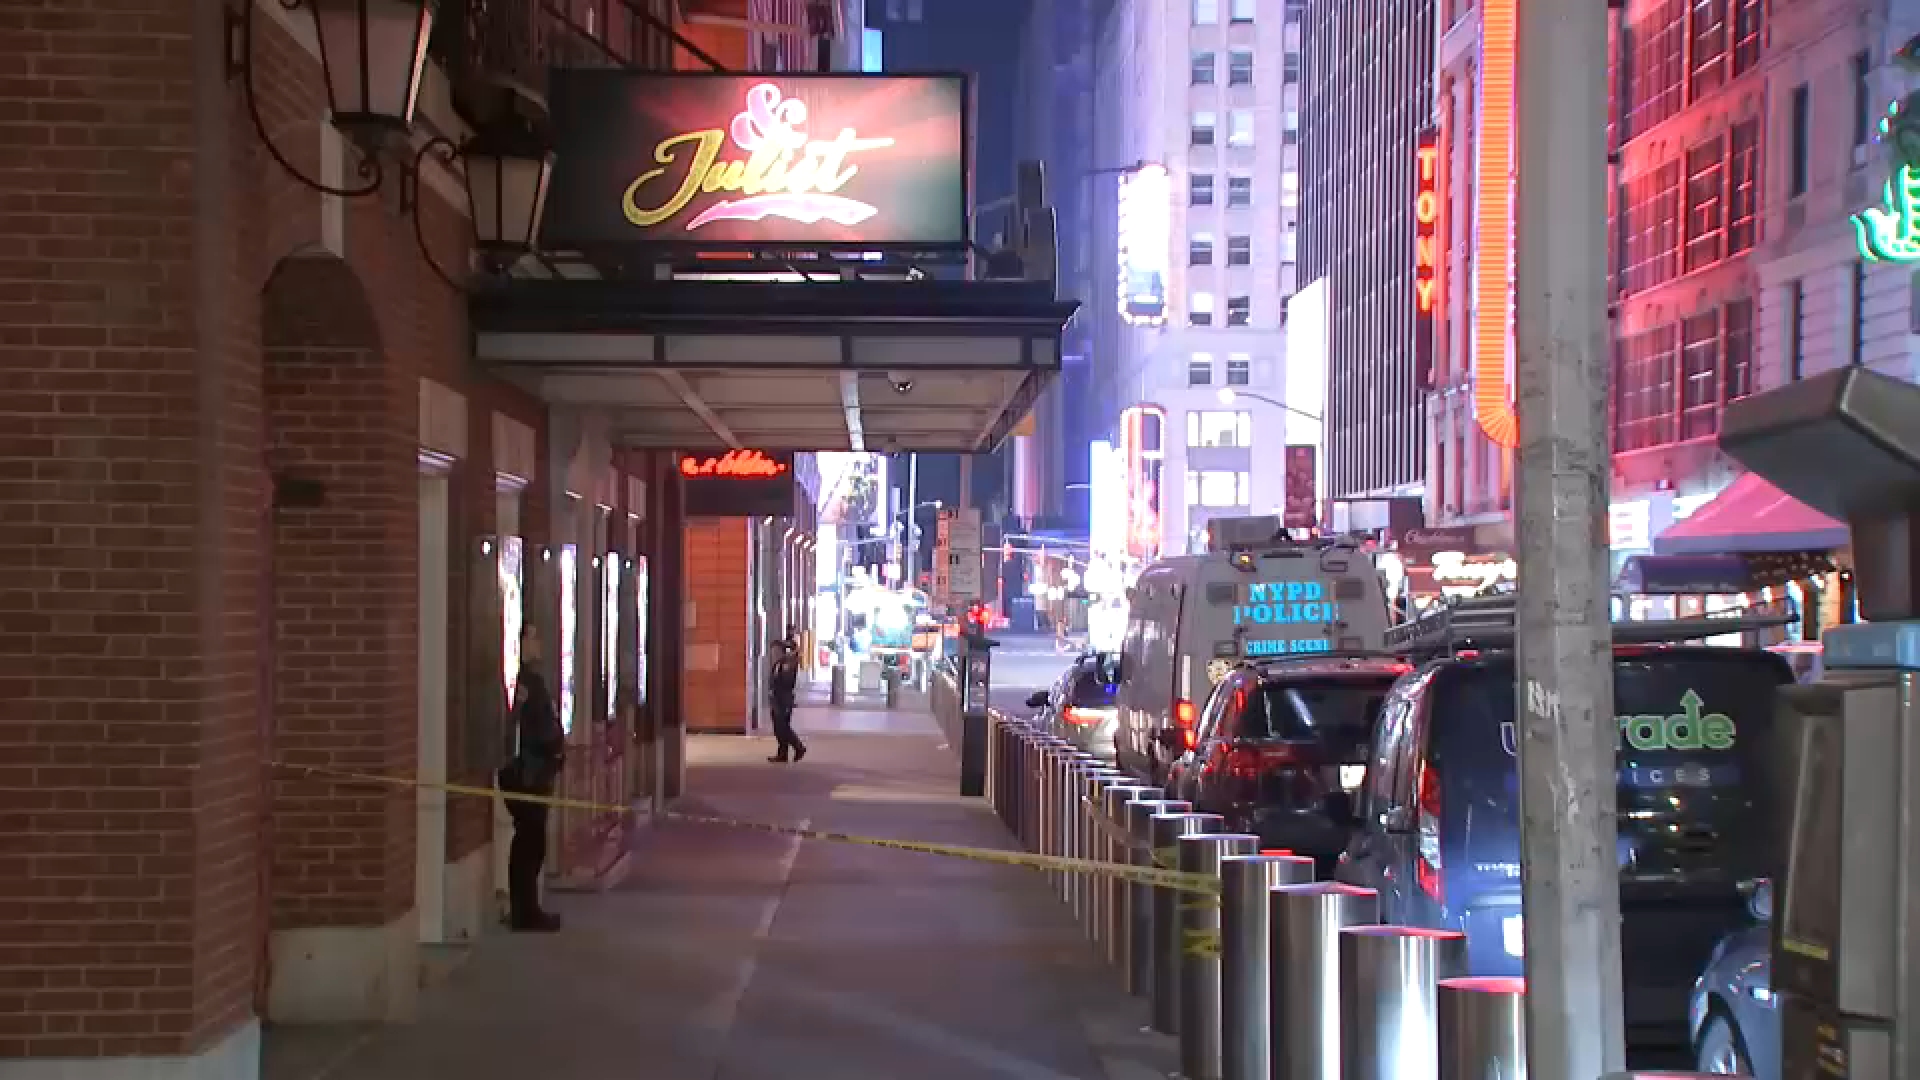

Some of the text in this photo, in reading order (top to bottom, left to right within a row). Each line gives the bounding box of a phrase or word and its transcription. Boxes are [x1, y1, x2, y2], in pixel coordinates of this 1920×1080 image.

[1416, 147, 1438, 312] TONY
[1248, 582, 1322, 602] NYPD
[1247, 639, 1285, 655] CRIME
